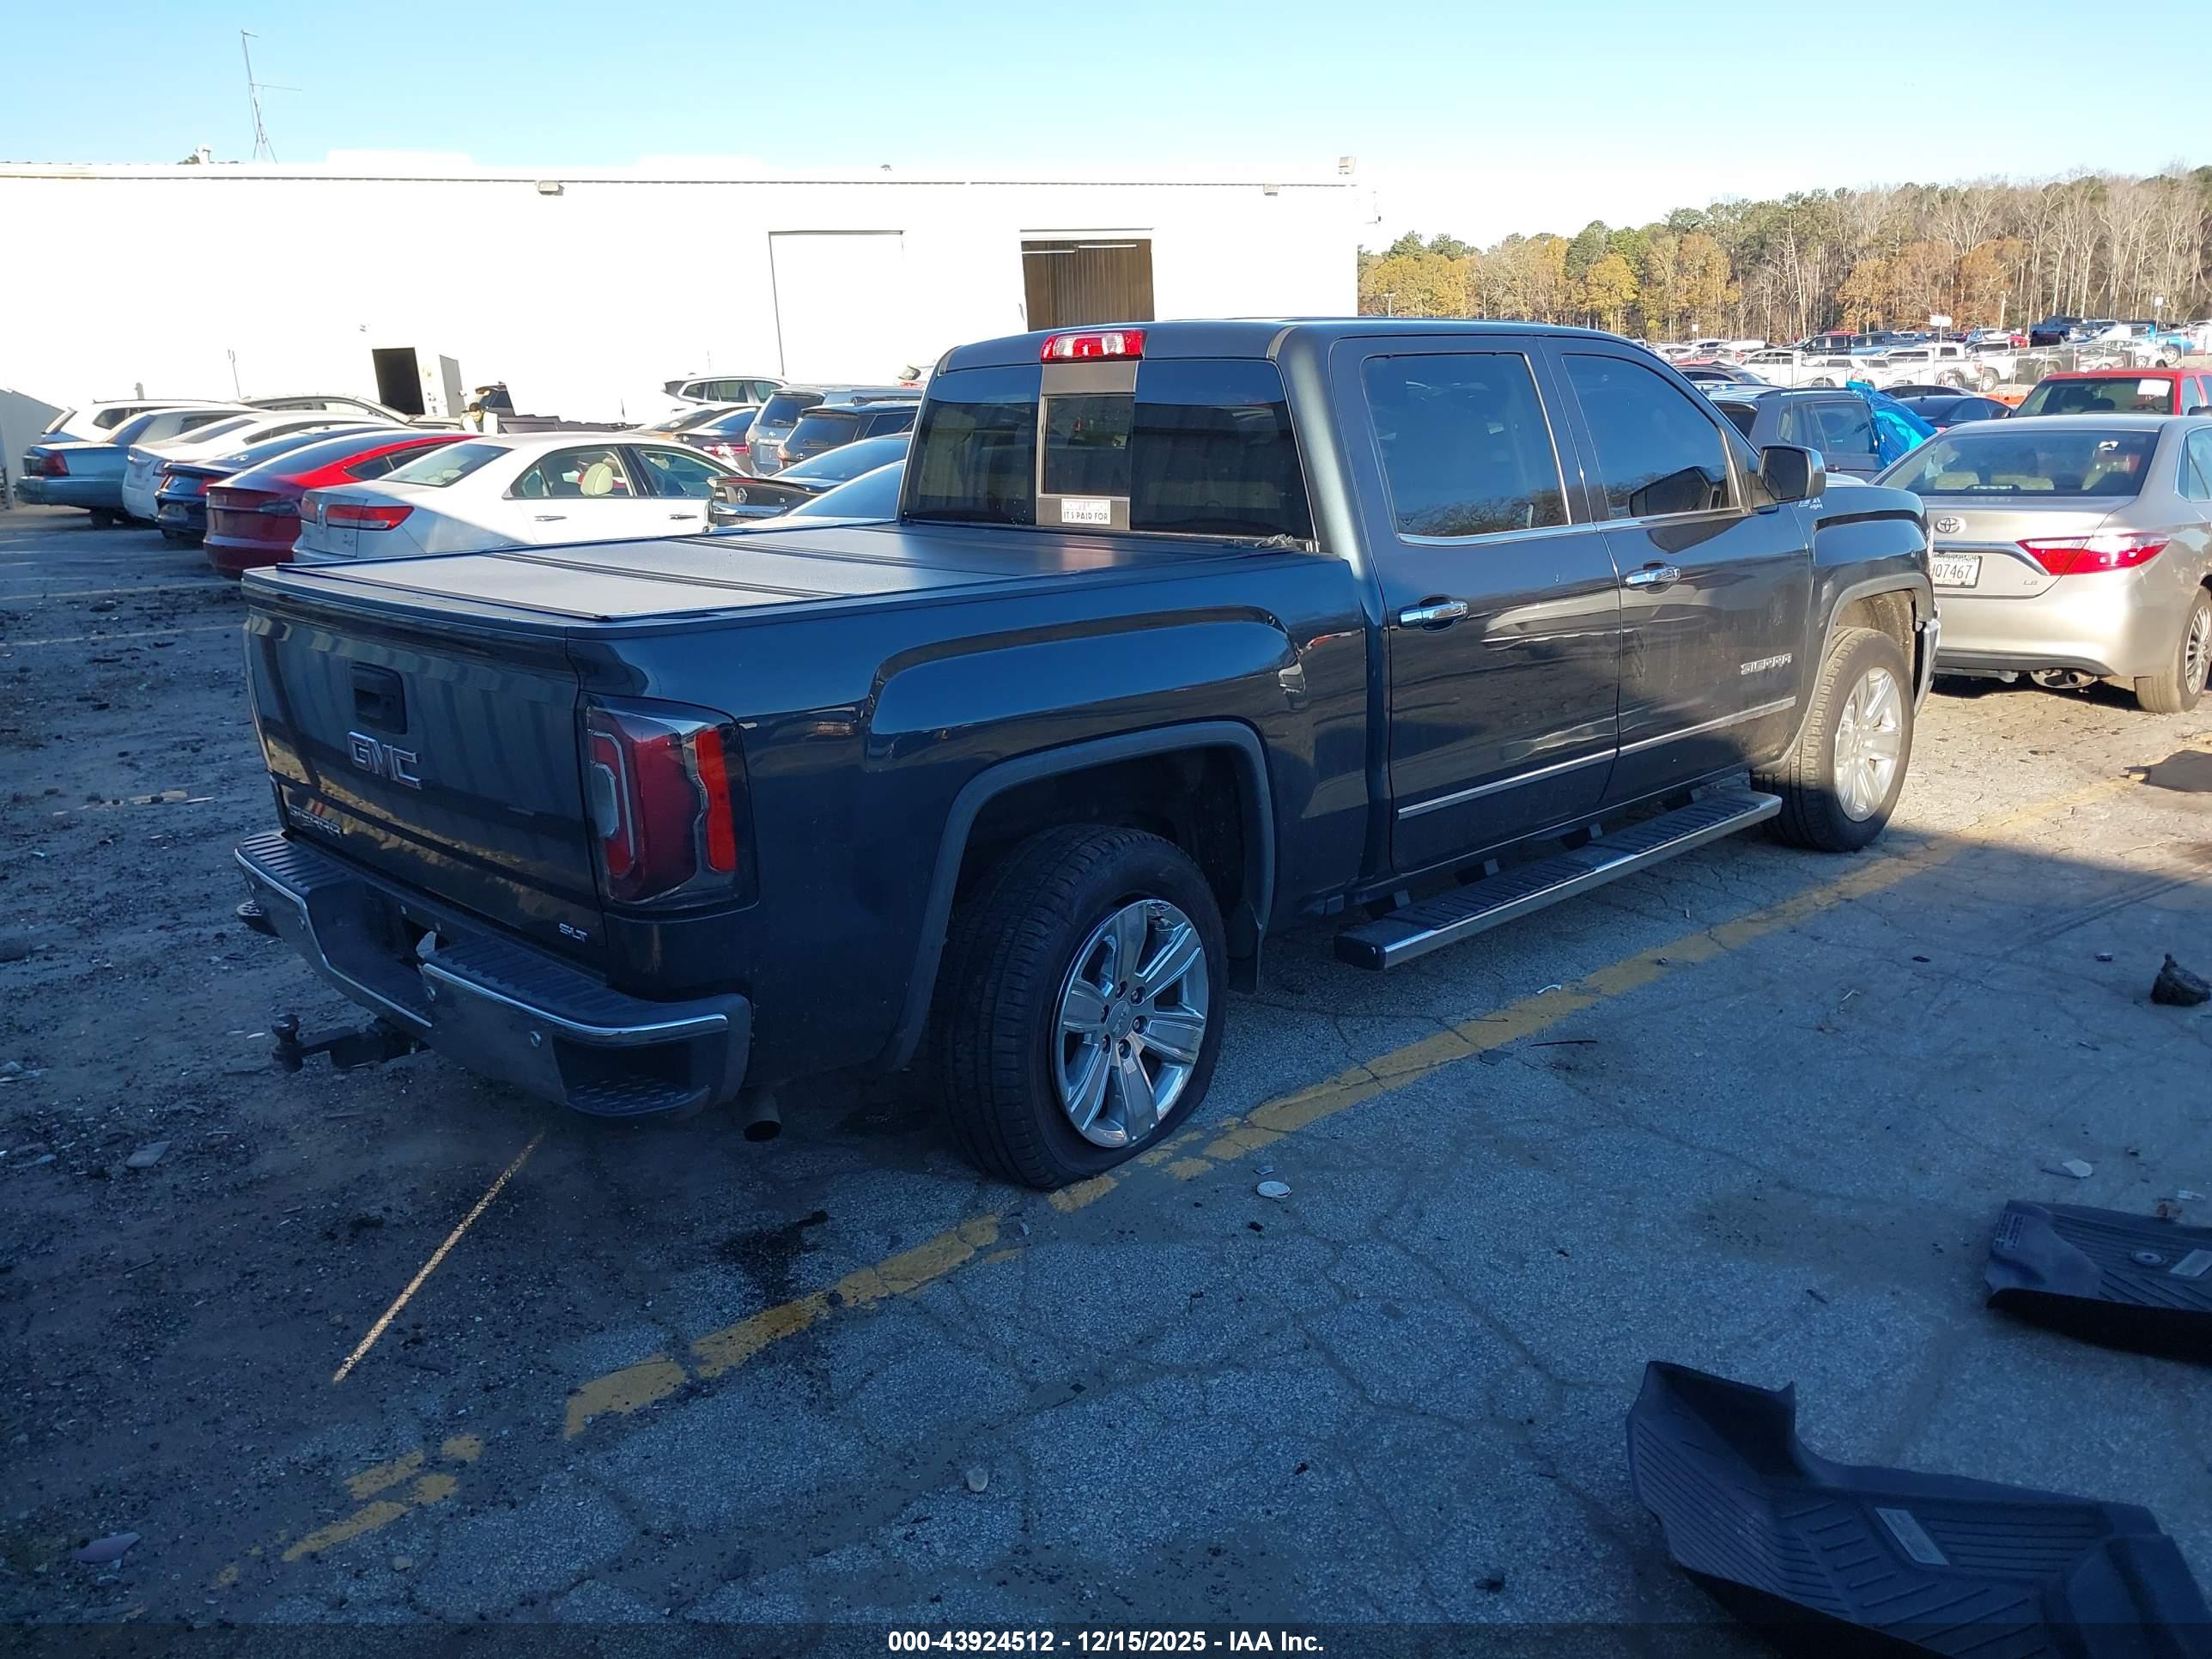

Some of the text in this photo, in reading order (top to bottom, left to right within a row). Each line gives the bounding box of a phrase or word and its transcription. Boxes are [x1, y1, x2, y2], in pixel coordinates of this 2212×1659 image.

[1076, 511, 1093, 520] PAID
[1094, 512, 1109, 521] FOR
[346, 731, 422, 790] GMC
[558, 922, 588, 943] SLT
